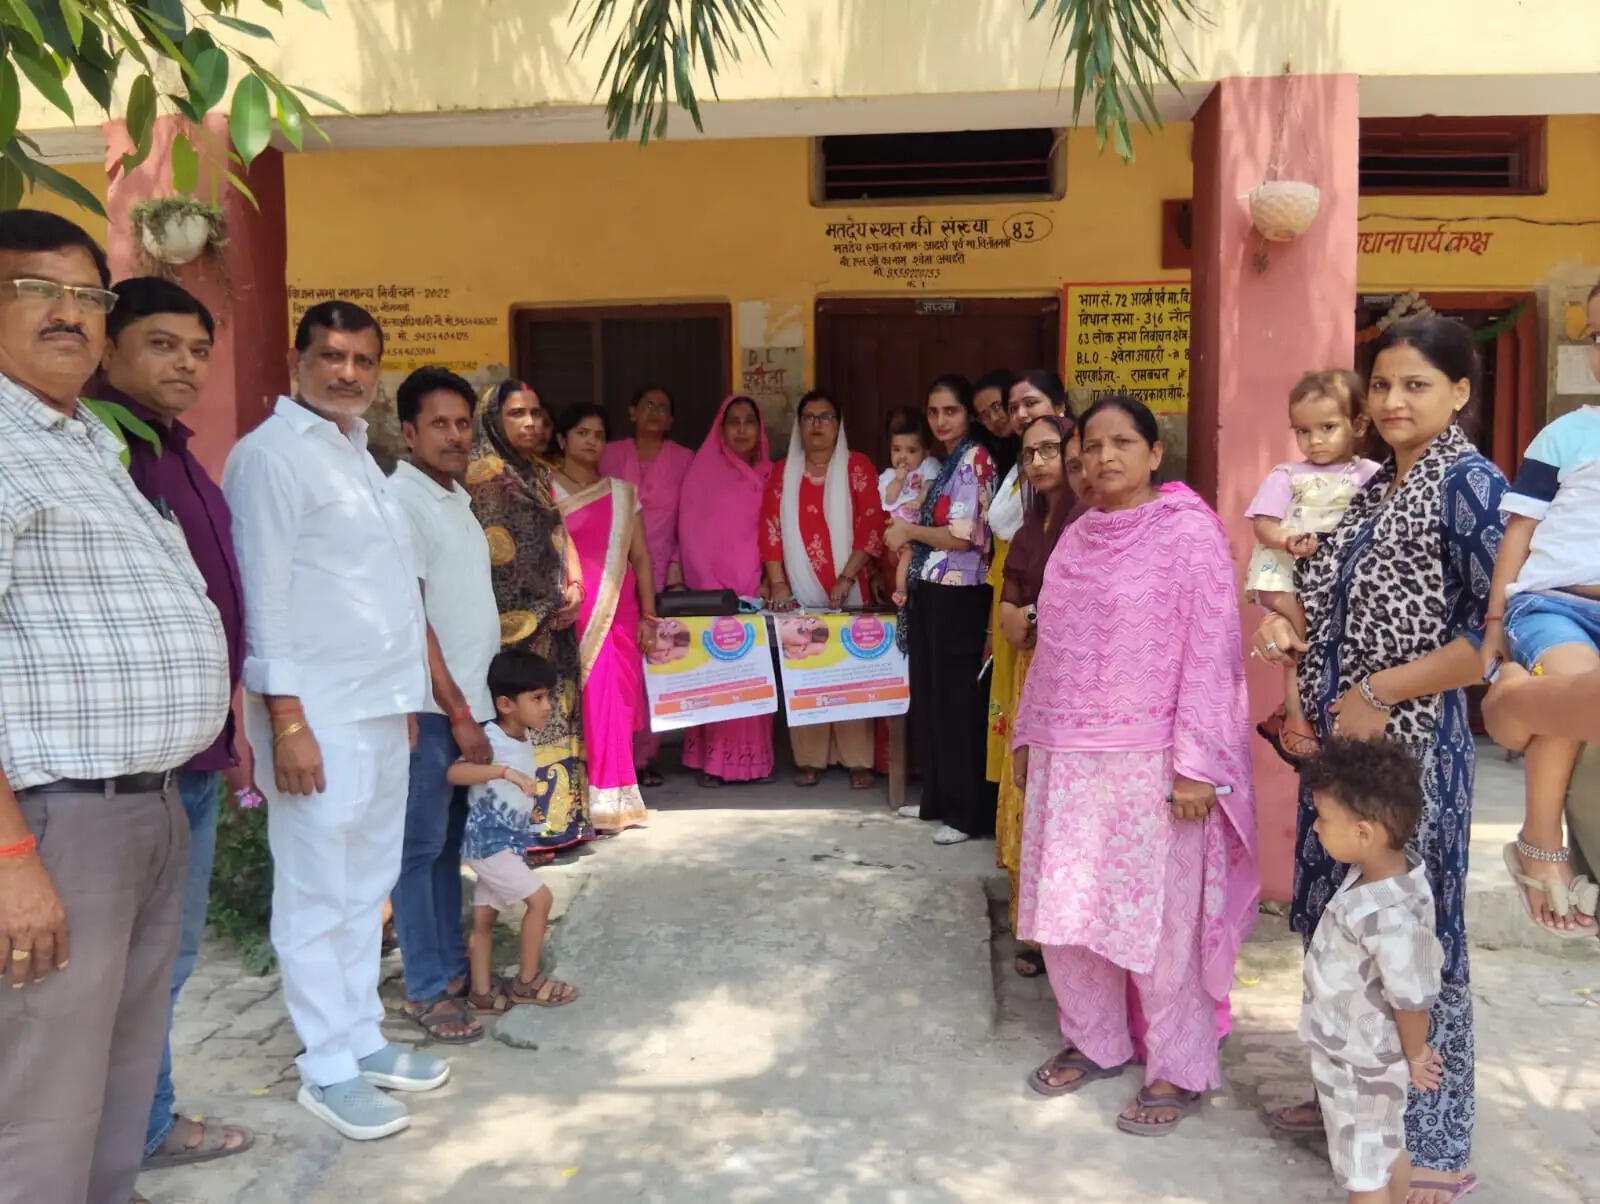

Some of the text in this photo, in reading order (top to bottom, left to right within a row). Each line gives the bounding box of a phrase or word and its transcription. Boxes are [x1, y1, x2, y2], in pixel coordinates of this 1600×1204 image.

[911, 215, 934, 236] की
[1012, 220, 1034, 239] 83
[1446, 231, 1493, 255] कक्ष
[1115, 293, 1128, 307] 72
[1078, 308, 1108, 327] विधान
[1111, 313, 1134, 326] सभा
[1092, 330, 1114, 344] लोक
